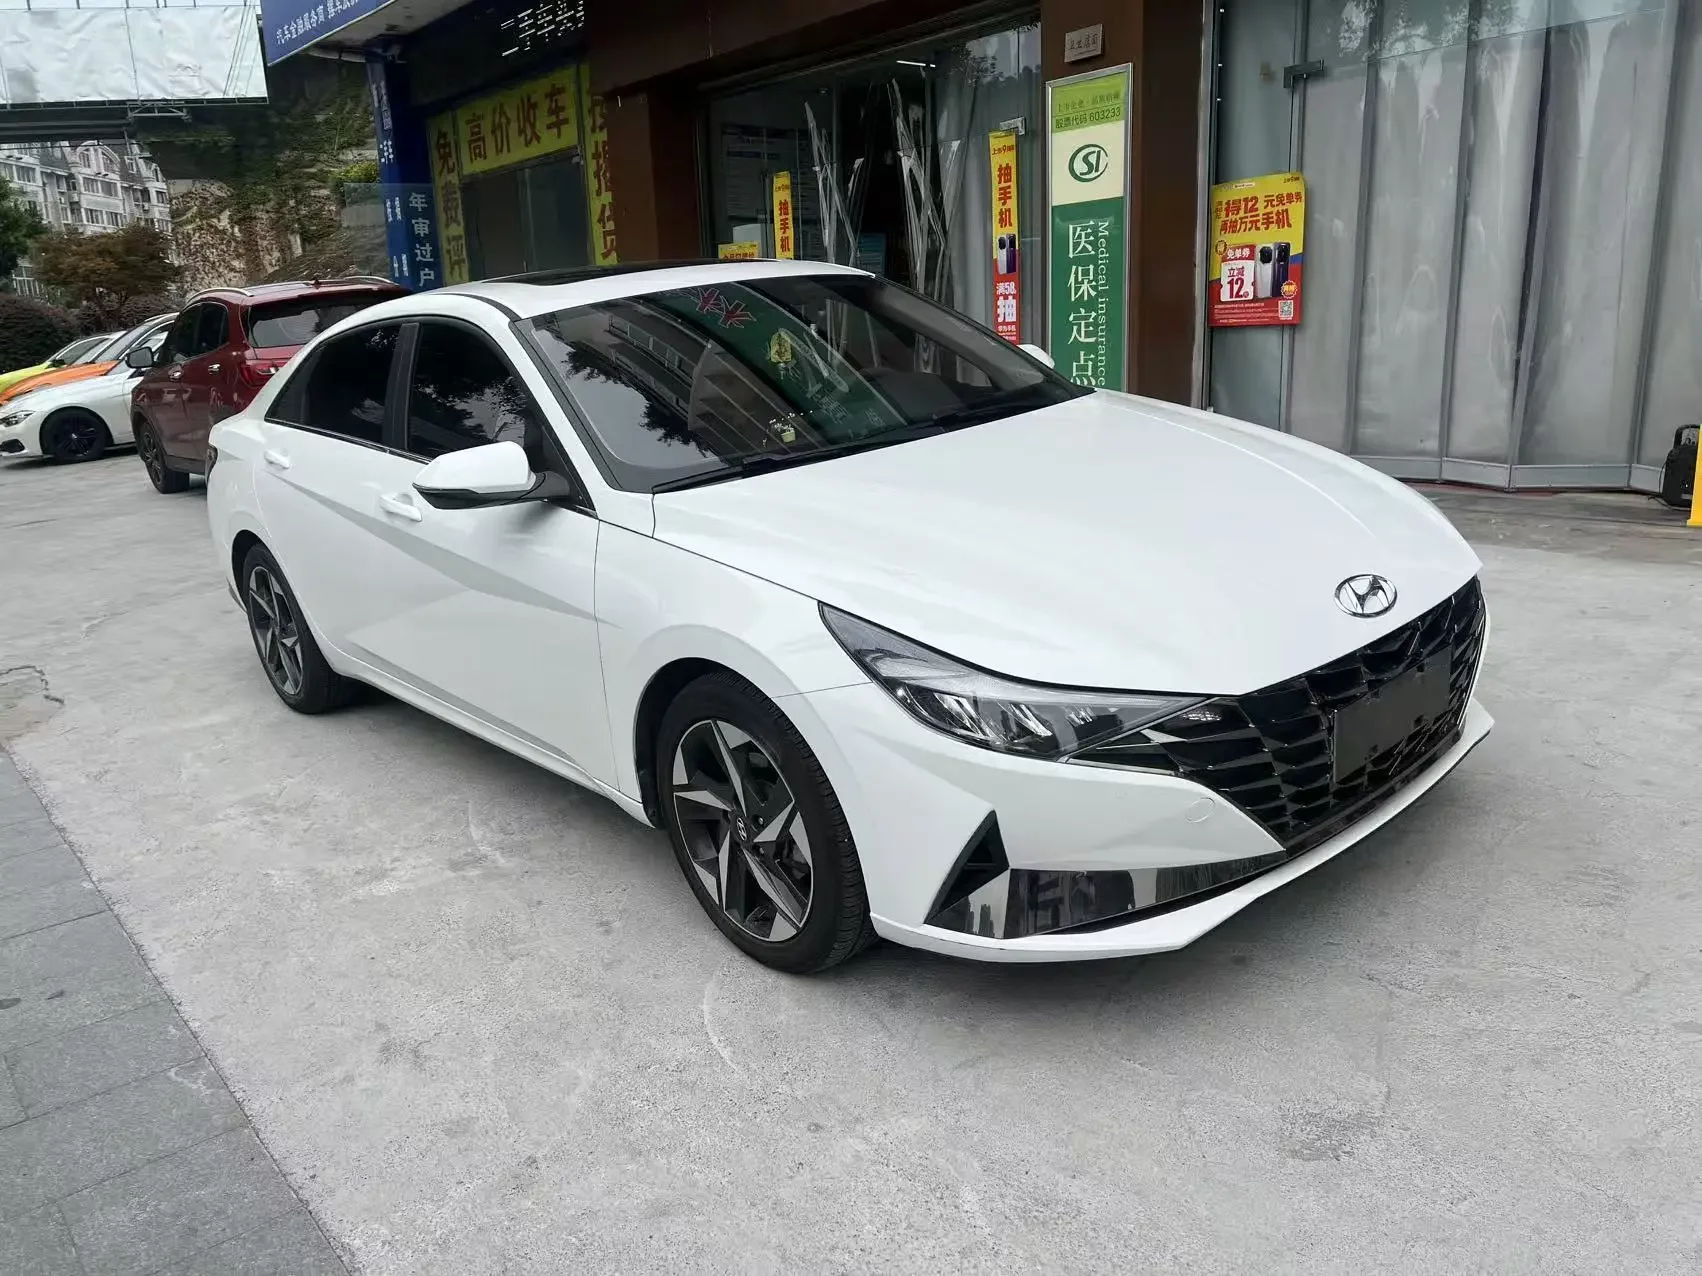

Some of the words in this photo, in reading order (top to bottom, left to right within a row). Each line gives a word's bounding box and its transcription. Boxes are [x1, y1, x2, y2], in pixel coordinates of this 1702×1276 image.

[465, 83, 570, 164] 高价收车
[1089, 106, 1121, 122] 603233
[778, 199, 790, 252] 抽手机
[997, 163, 1012, 229] 抽手机
[1220, 208, 1292, 234] 再抽万元手机
[408, 192, 435, 287] 年审过户
[1097, 221, 1110, 291] Medical
[1226, 247, 1250, 259] 免单券
[1227, 266, 1245, 278] 立减
[997, 295, 1016, 323] 抽
[1067, 220, 1097, 387] 医保定点
[1097, 297, 1110, 387] insurance
